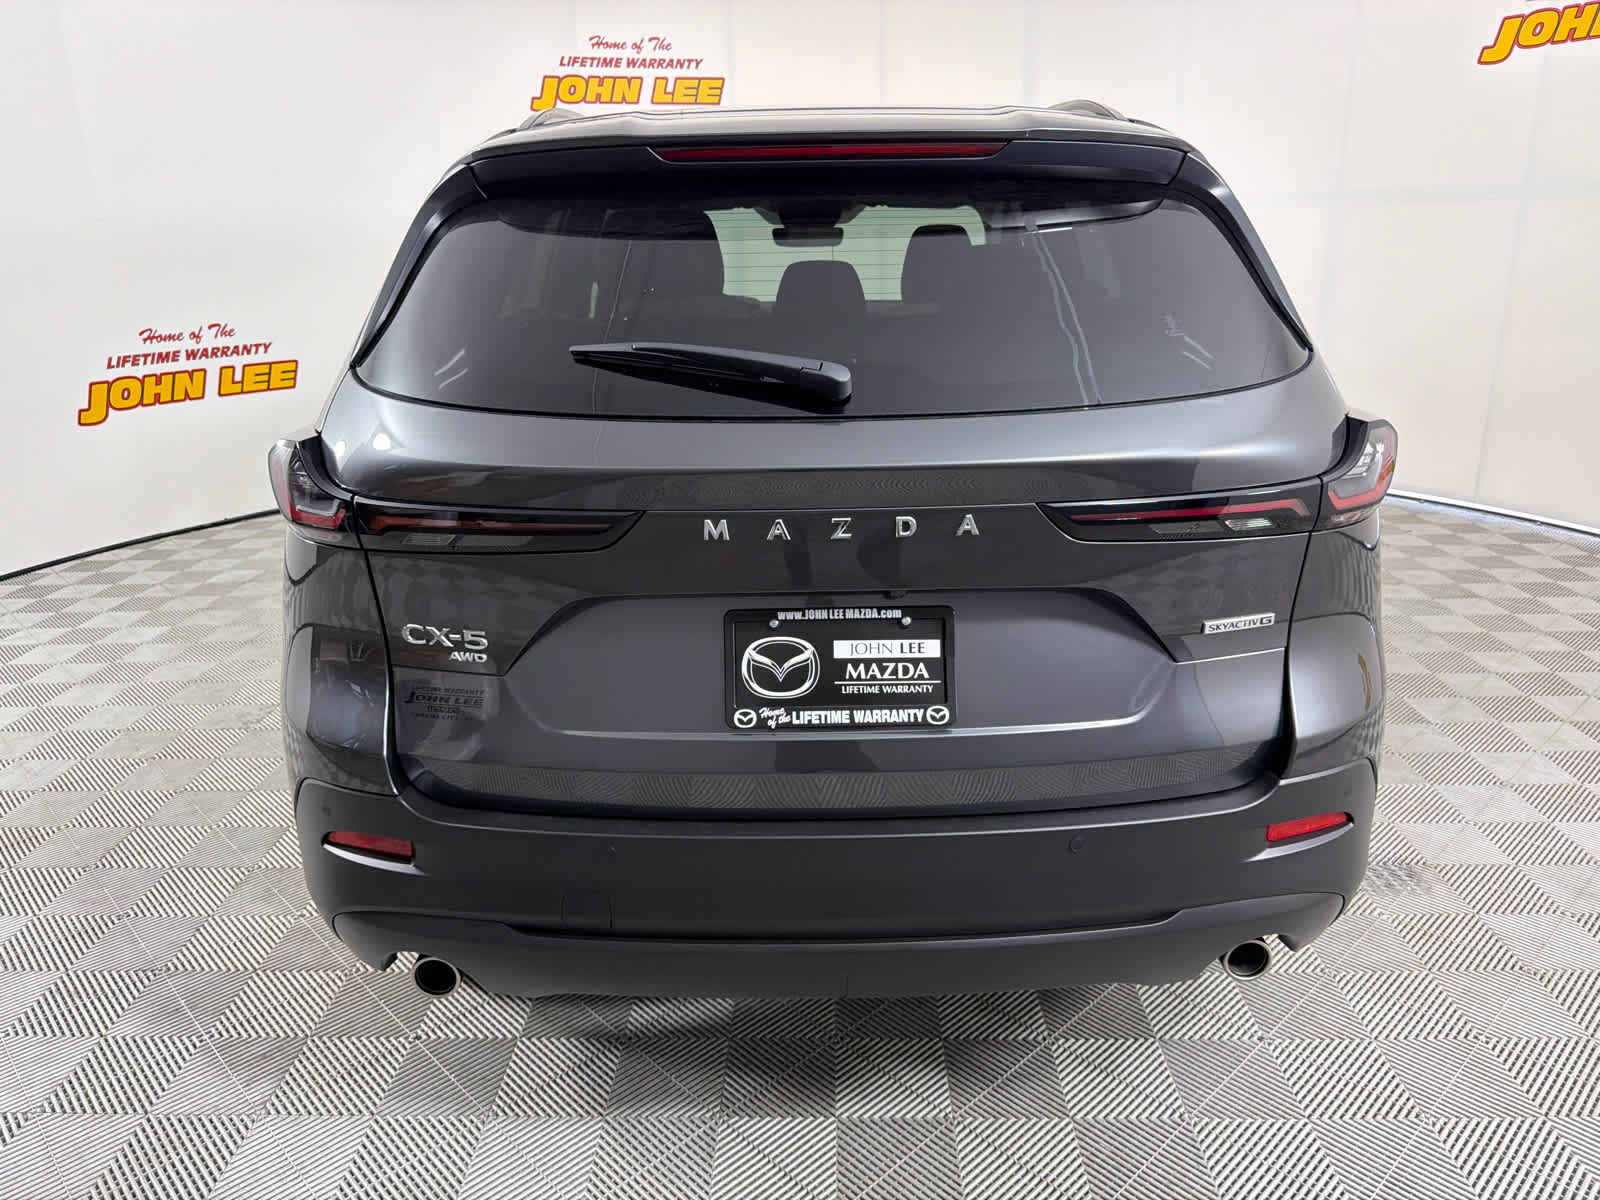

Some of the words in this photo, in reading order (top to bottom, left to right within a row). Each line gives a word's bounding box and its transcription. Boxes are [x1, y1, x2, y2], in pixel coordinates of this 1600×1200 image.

[1477, 1, 1600, 65] JOH
[588, 35, 628, 51] Home
[631, 37, 645, 54] of
[648, 37, 673, 51] The
[559, 56, 622, 68] LIFETIME
[626, 57, 704, 70] WARRANTY
[530, 74, 643, 112] JOHN
[650, 76, 725, 105] LEE
[139, 328, 184, 344] Home
[189, 326, 202, 344] of
[207, 323, 236, 339] The
[106, 350, 180, 369] LIFETIME
[186, 342, 272, 361] WARRANTY
[78, 368, 207, 426] JOHN
[217, 359, 298, 397] LEE
[703, 513, 980, 541] MAZDA
[401, 623, 489, 650] CX-5
[448, 651, 488, 662] AWD
[850, 643, 893, 656] JOHN
[900, 642, 926, 654] LEE
[845, 663, 930, 679] MAZDA
[841, 685, 880, 694] LIFETIME
[882, 684, 933, 694] WARRANTY
[759, 707, 785, 719] Home
[792, 711, 850, 725] LIFETIME
[853, 709, 924, 724] WARRANTY
